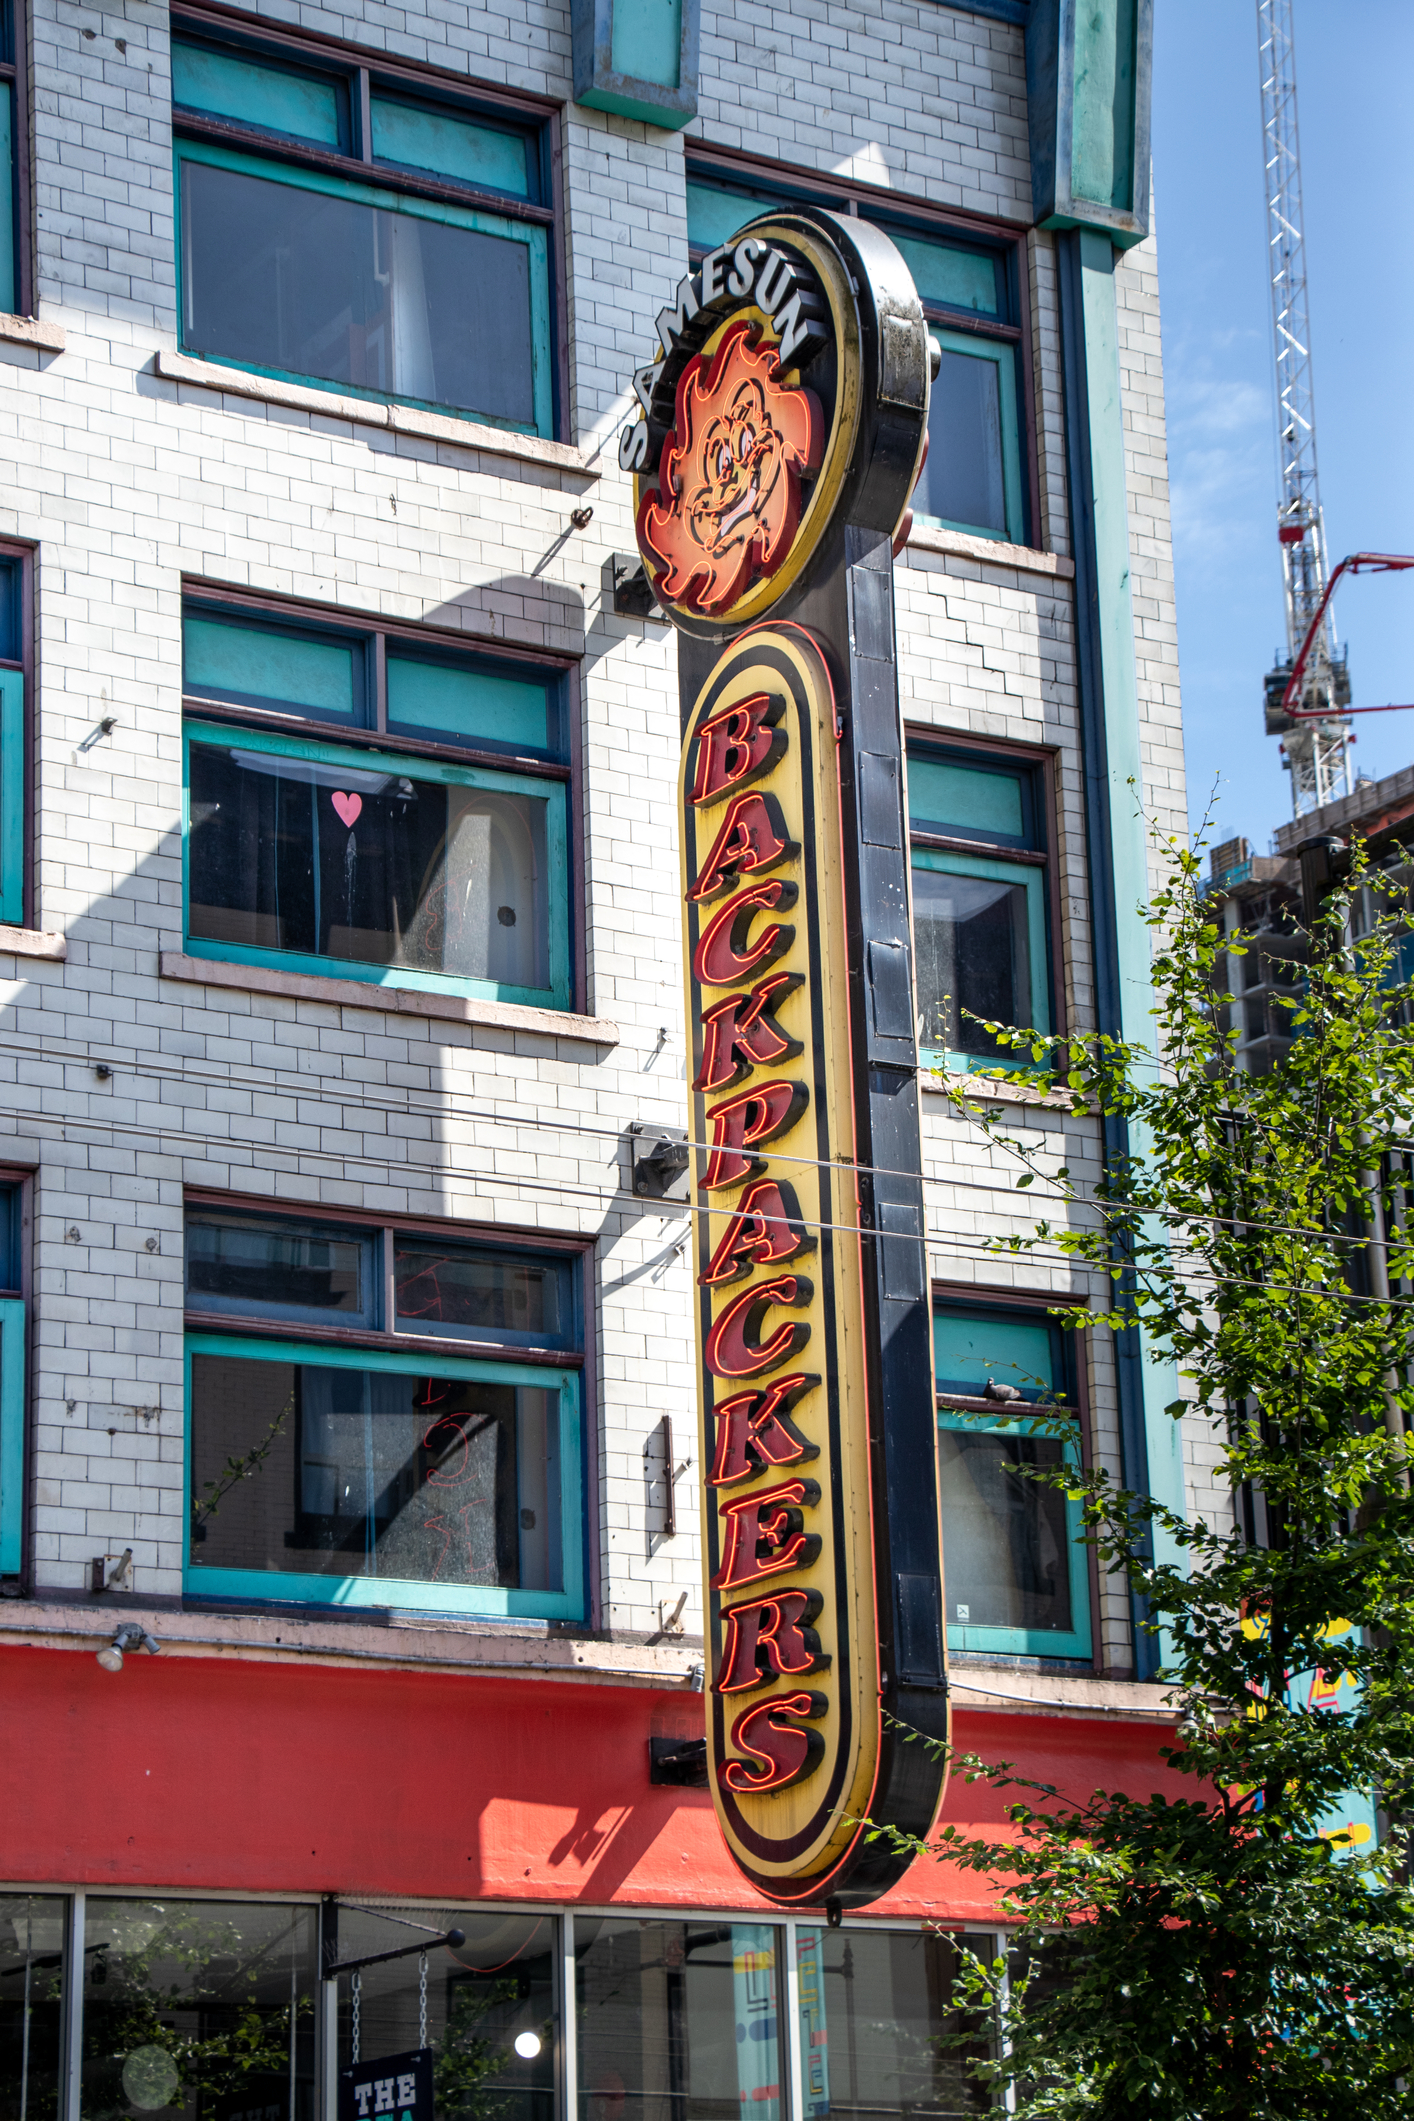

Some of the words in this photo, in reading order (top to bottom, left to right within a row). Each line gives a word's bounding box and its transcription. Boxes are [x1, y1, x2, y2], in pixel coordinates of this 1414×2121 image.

[618, 238, 828, 473] SAMESUN
[685, 692, 830, 1795] BACKPACKERS
[354, 2073, 416, 2116] THE
